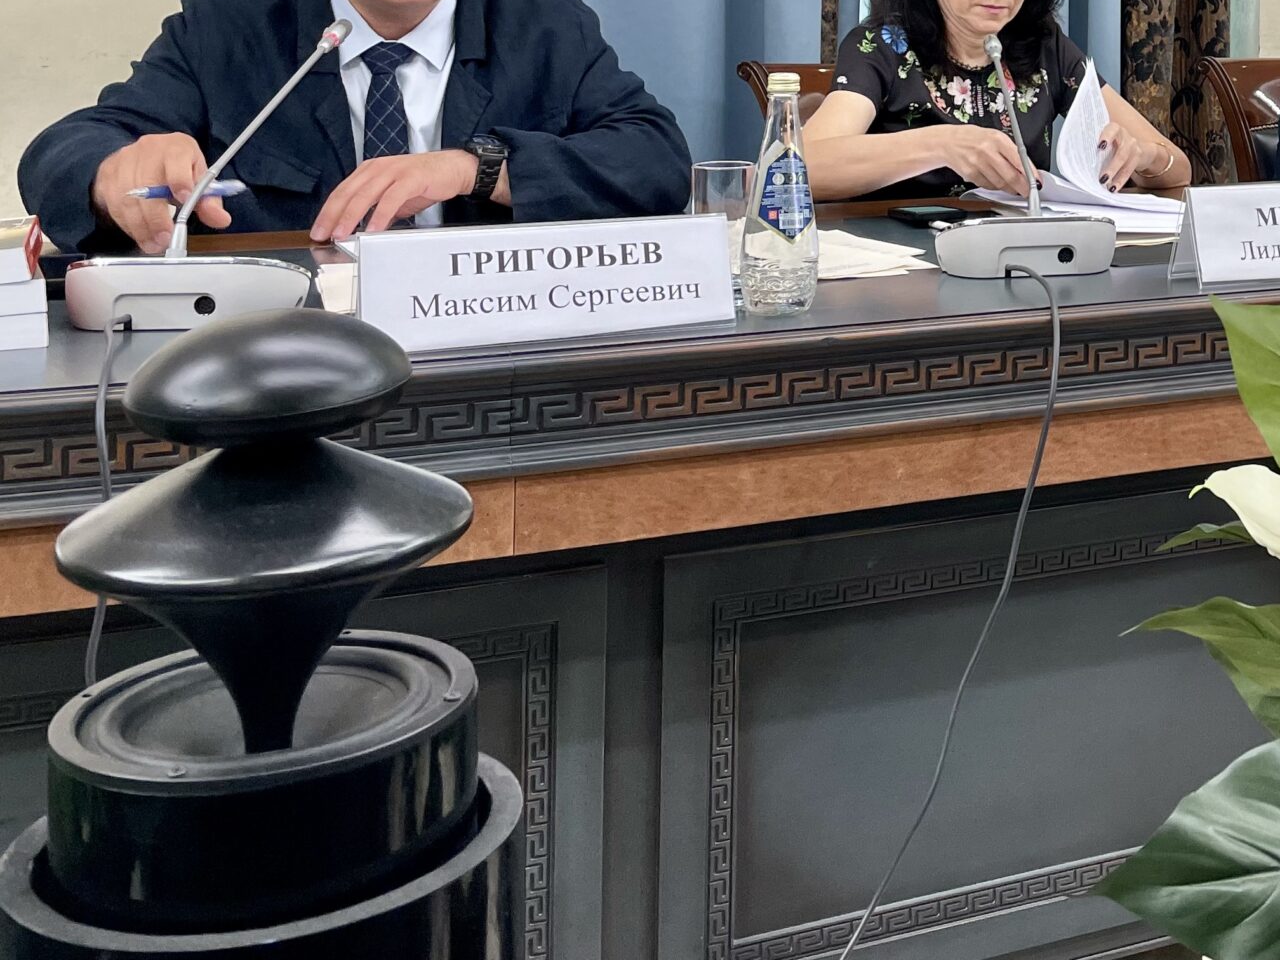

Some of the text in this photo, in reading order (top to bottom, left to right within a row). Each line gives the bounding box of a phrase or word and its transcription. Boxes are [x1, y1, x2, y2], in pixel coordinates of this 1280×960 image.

[448, 241, 664, 277] ГРИГОРЬЕВ
[410, 281, 702, 319] Максим Сергеевич
